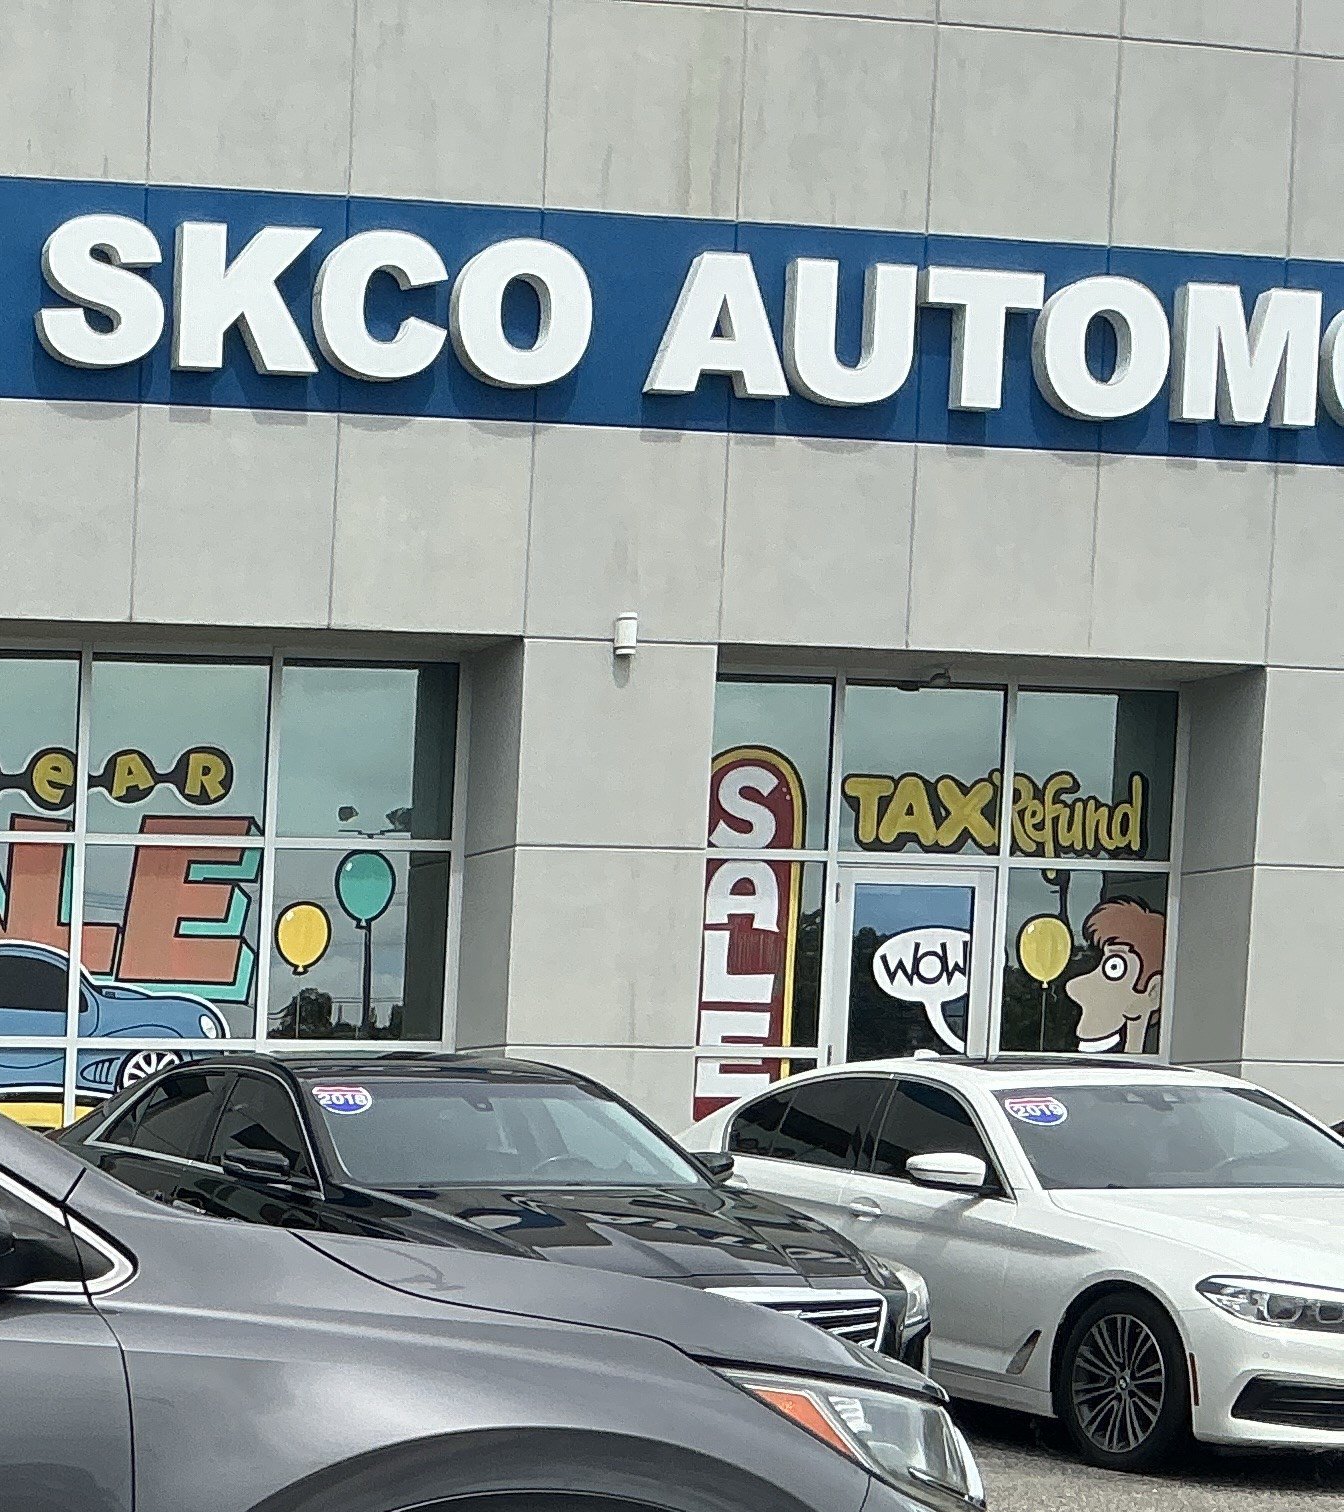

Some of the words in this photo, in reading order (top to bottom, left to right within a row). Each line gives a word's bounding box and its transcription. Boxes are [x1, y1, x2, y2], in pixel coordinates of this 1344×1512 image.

[34, 212, 594, 388] SKCO
[642, 251, 1344, 428] AUTOM
[844, 775, 997, 847] TAX
[694, 765, 780, 1098] SALE
